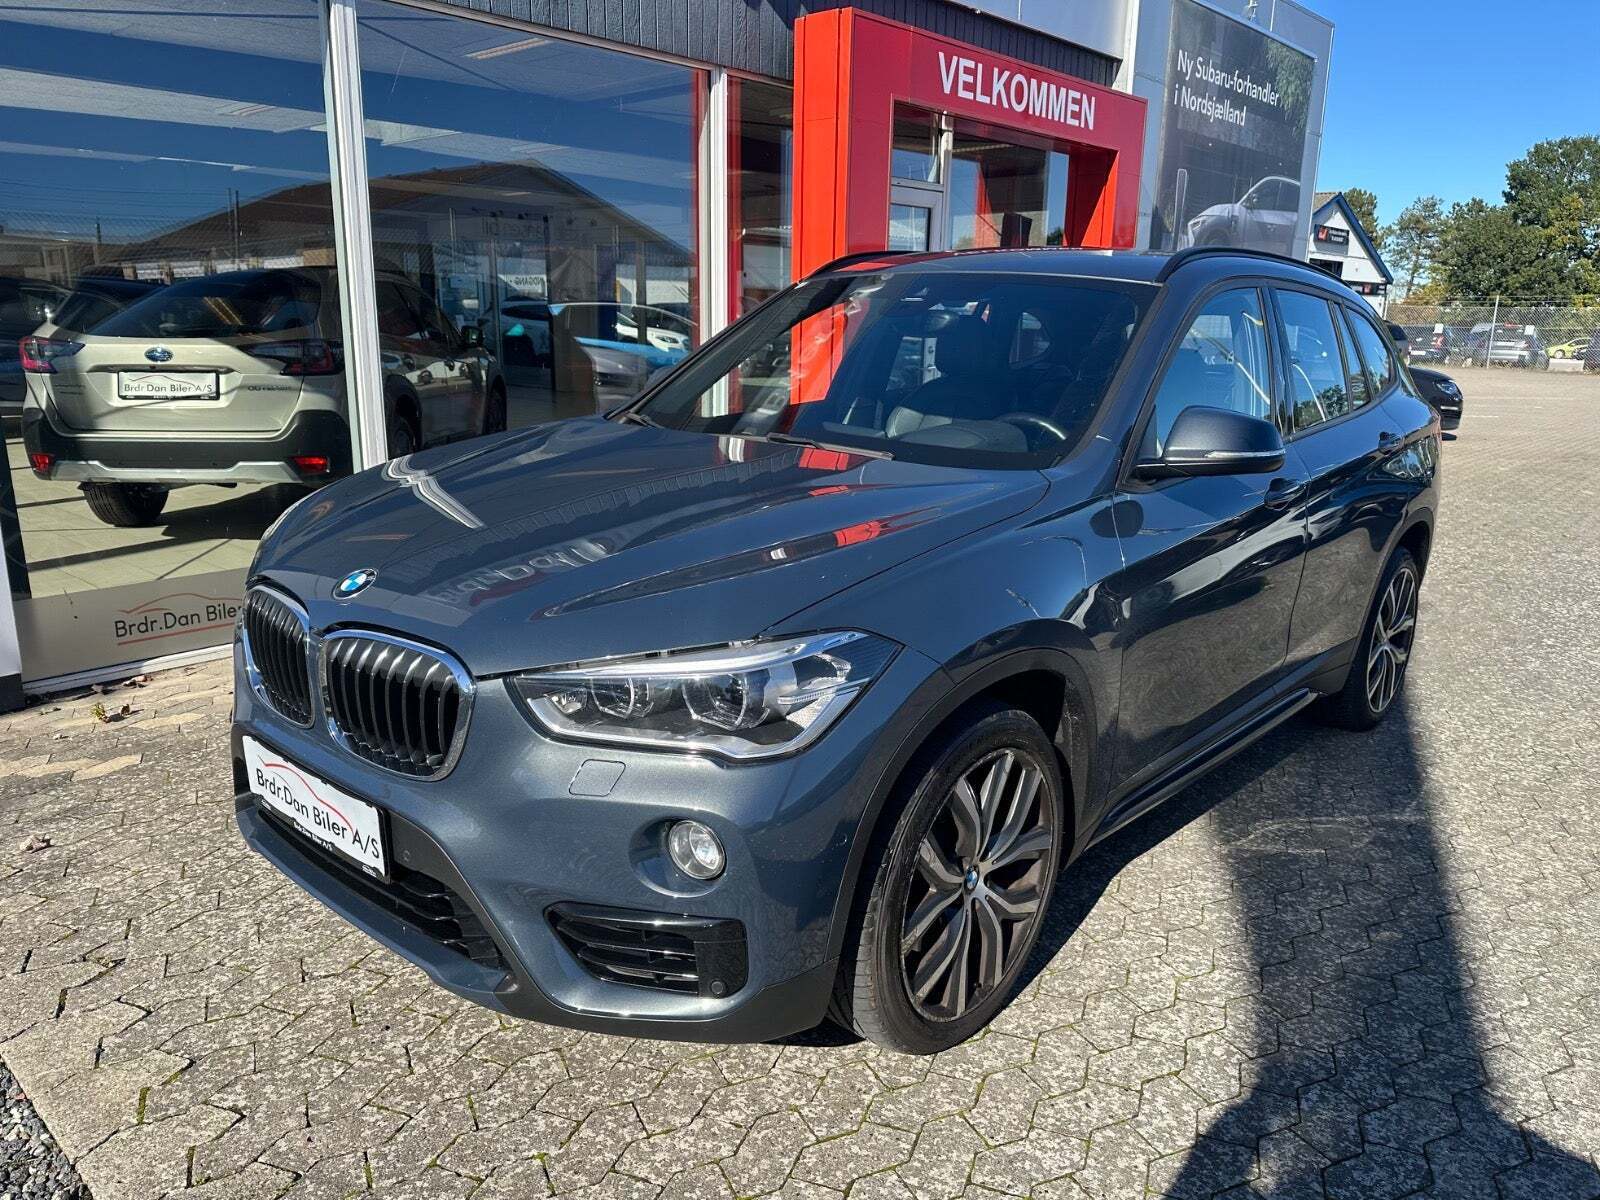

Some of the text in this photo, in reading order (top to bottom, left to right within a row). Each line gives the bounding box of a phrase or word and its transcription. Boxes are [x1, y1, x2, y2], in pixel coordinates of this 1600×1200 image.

[938, 51, 1096, 130] VELKOMMEN
[1177, 49, 1279, 106] Ny Subaru-forhandler
[1174, 83, 1247, 126] i Nordsjælland
[146, 383, 167, 392] Dan
[195, 384, 213, 393] A/S
[313, 806, 348, 839] Biler
[352, 829, 380, 859] A/S
